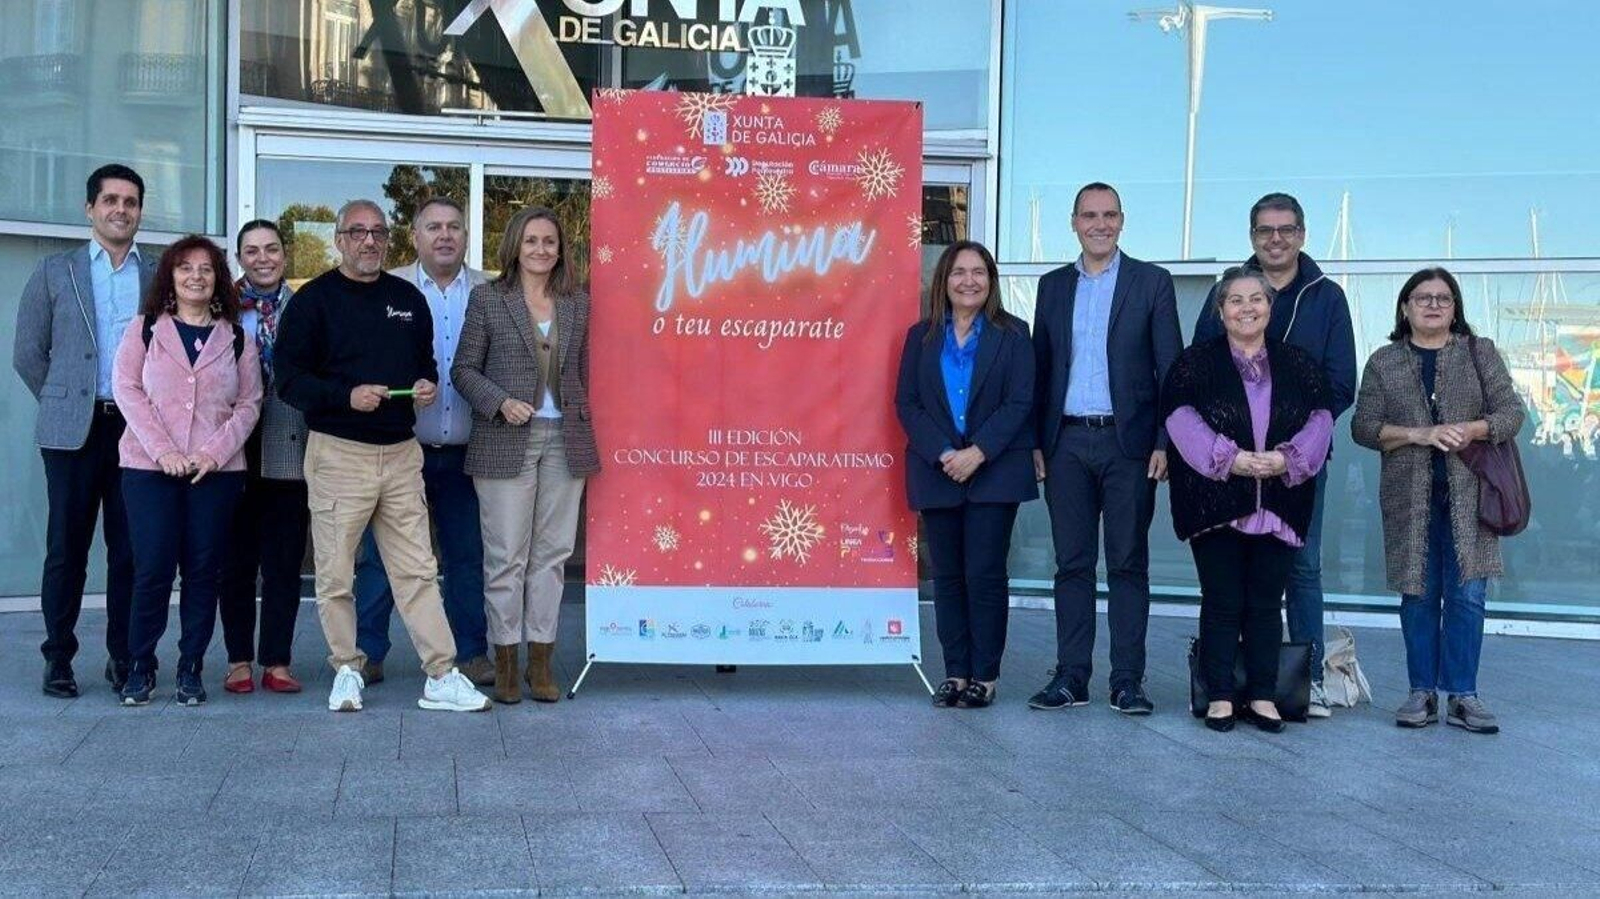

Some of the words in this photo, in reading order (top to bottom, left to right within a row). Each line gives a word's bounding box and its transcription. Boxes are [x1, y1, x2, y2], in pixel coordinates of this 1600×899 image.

[559, 16, 601, 43] DE
[613, 19, 740, 50] GALICIA
[733, 114, 784, 129] XUNTA
[732, 130, 751, 143] DE
[756, 131, 816, 146] GALICIA
[652, 316, 665, 334] o
[676, 313, 711, 336] teu
[720, 316, 845, 349] escaparate
[708, 429, 722, 445] III
[727, 427, 802, 445] EDICIÓN
[614, 449, 720, 466] CONCURSO
[725, 450, 748, 467] DE
[754, 451, 894, 468] ESCAPARATISMO
[696, 471, 736, 488] 2024
[740, 472, 763, 488] EN
[769, 472, 813, 489] VIGO
